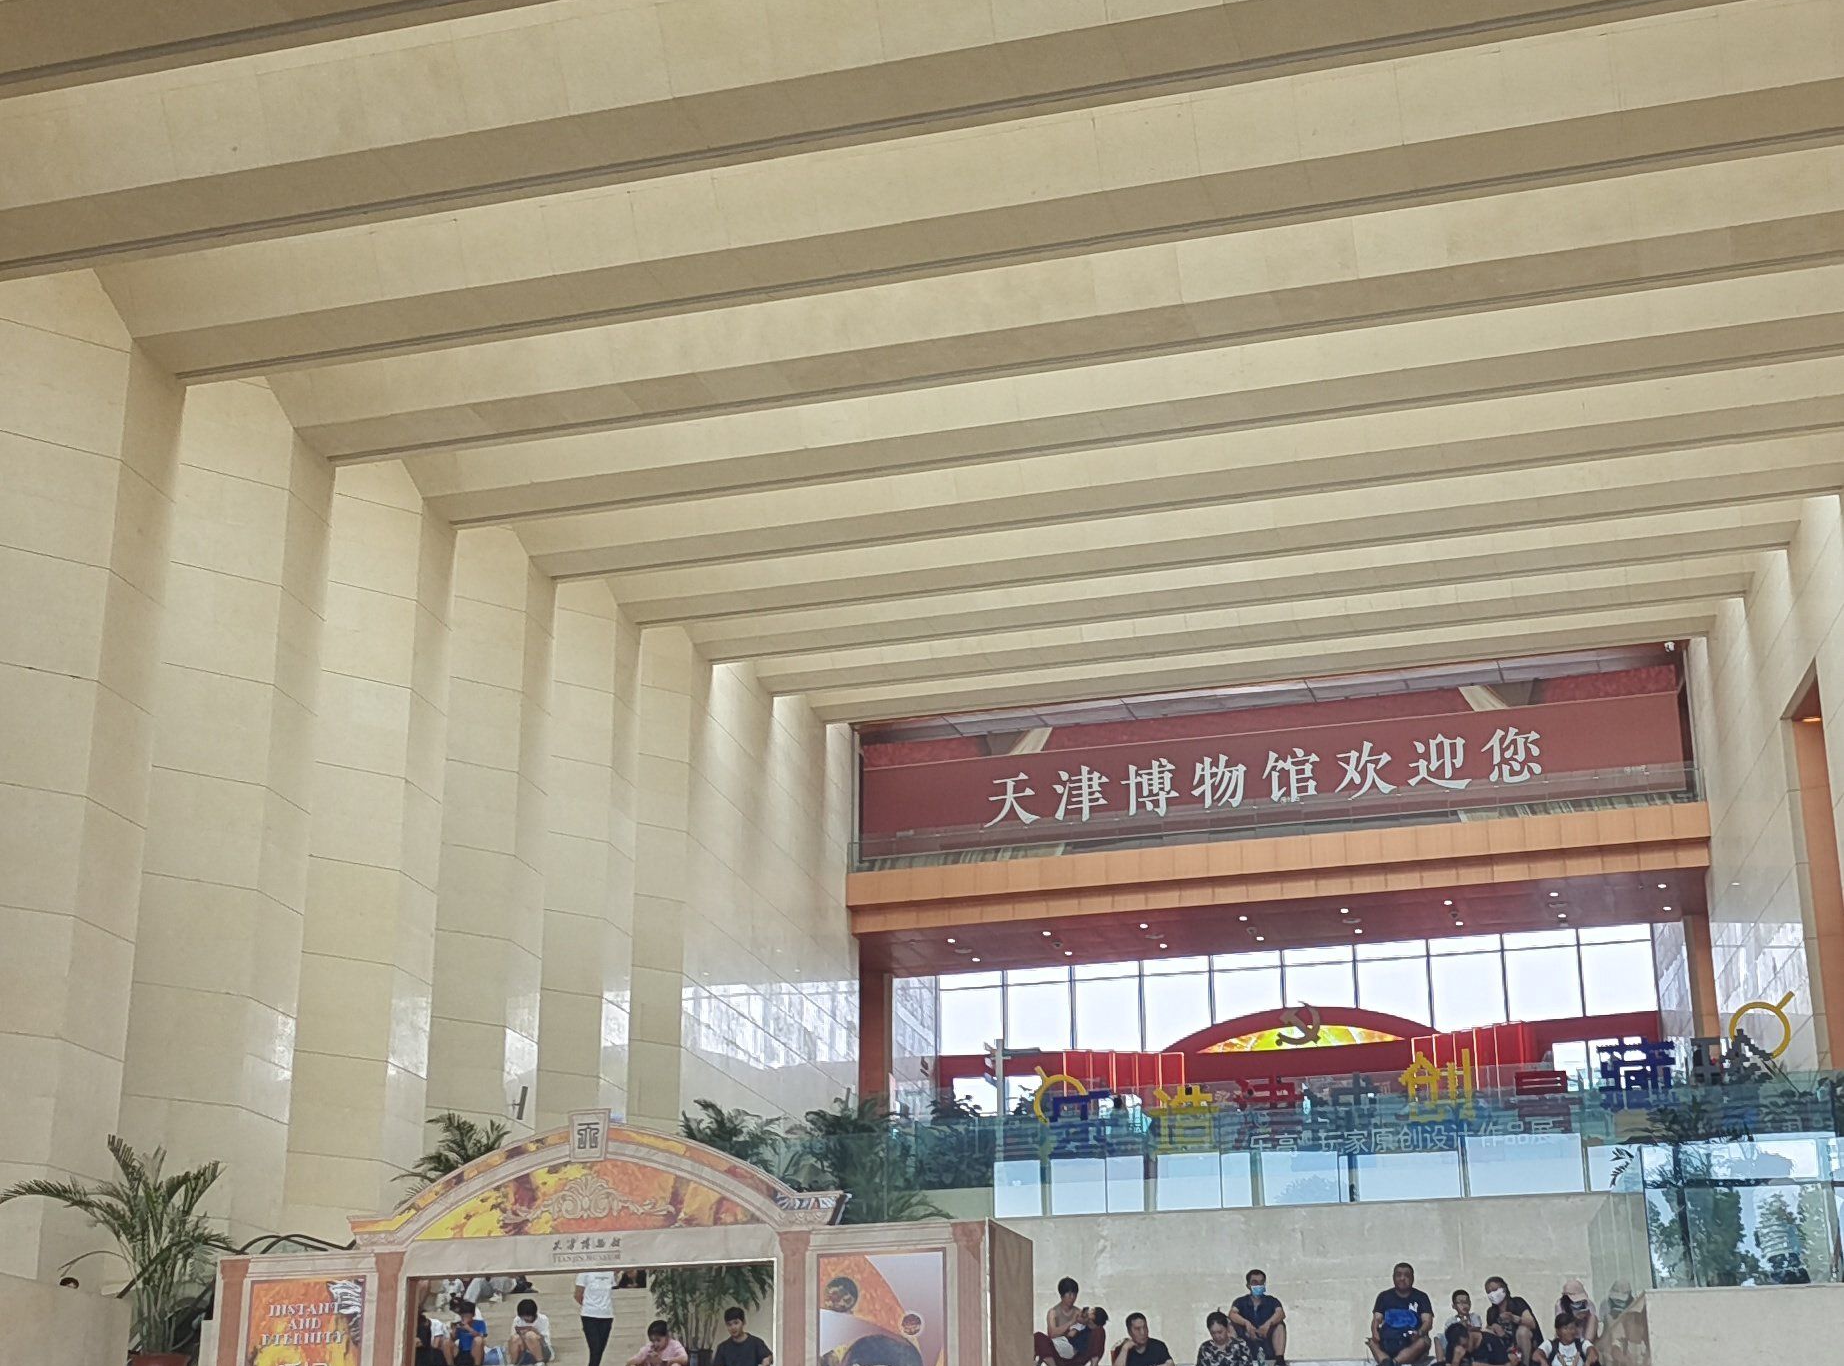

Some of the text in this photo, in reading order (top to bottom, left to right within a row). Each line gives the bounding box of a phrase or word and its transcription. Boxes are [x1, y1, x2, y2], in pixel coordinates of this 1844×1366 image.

[984, 726, 1542, 828] 天津博物馆欢迎您
[288, 1317, 322, 1331] AND
[261, 1330, 345, 1347] ETERNITY
